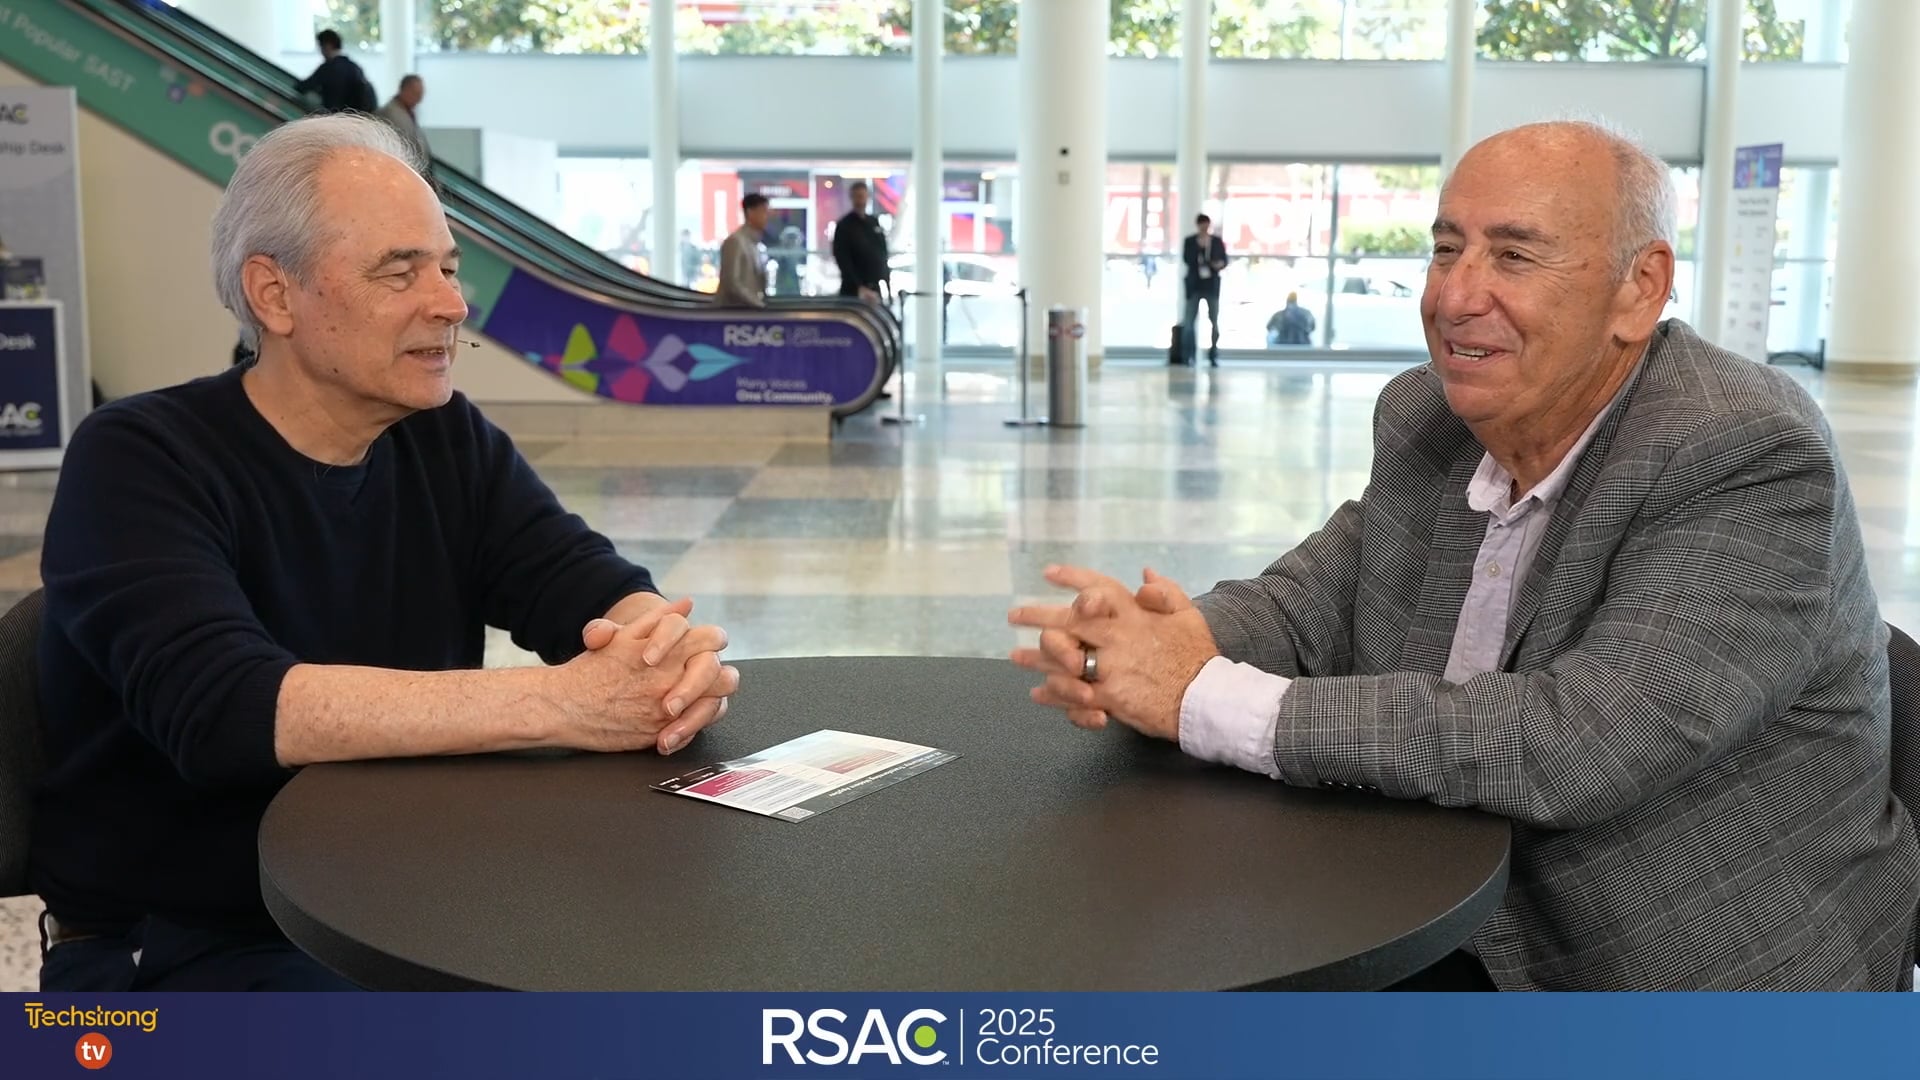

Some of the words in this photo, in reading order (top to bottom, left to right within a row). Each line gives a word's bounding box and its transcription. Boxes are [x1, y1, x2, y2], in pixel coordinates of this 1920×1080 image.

[13, 13, 81, 62] Popular
[723, 324, 785, 347] RSAC
[735, 389, 763, 402] One
